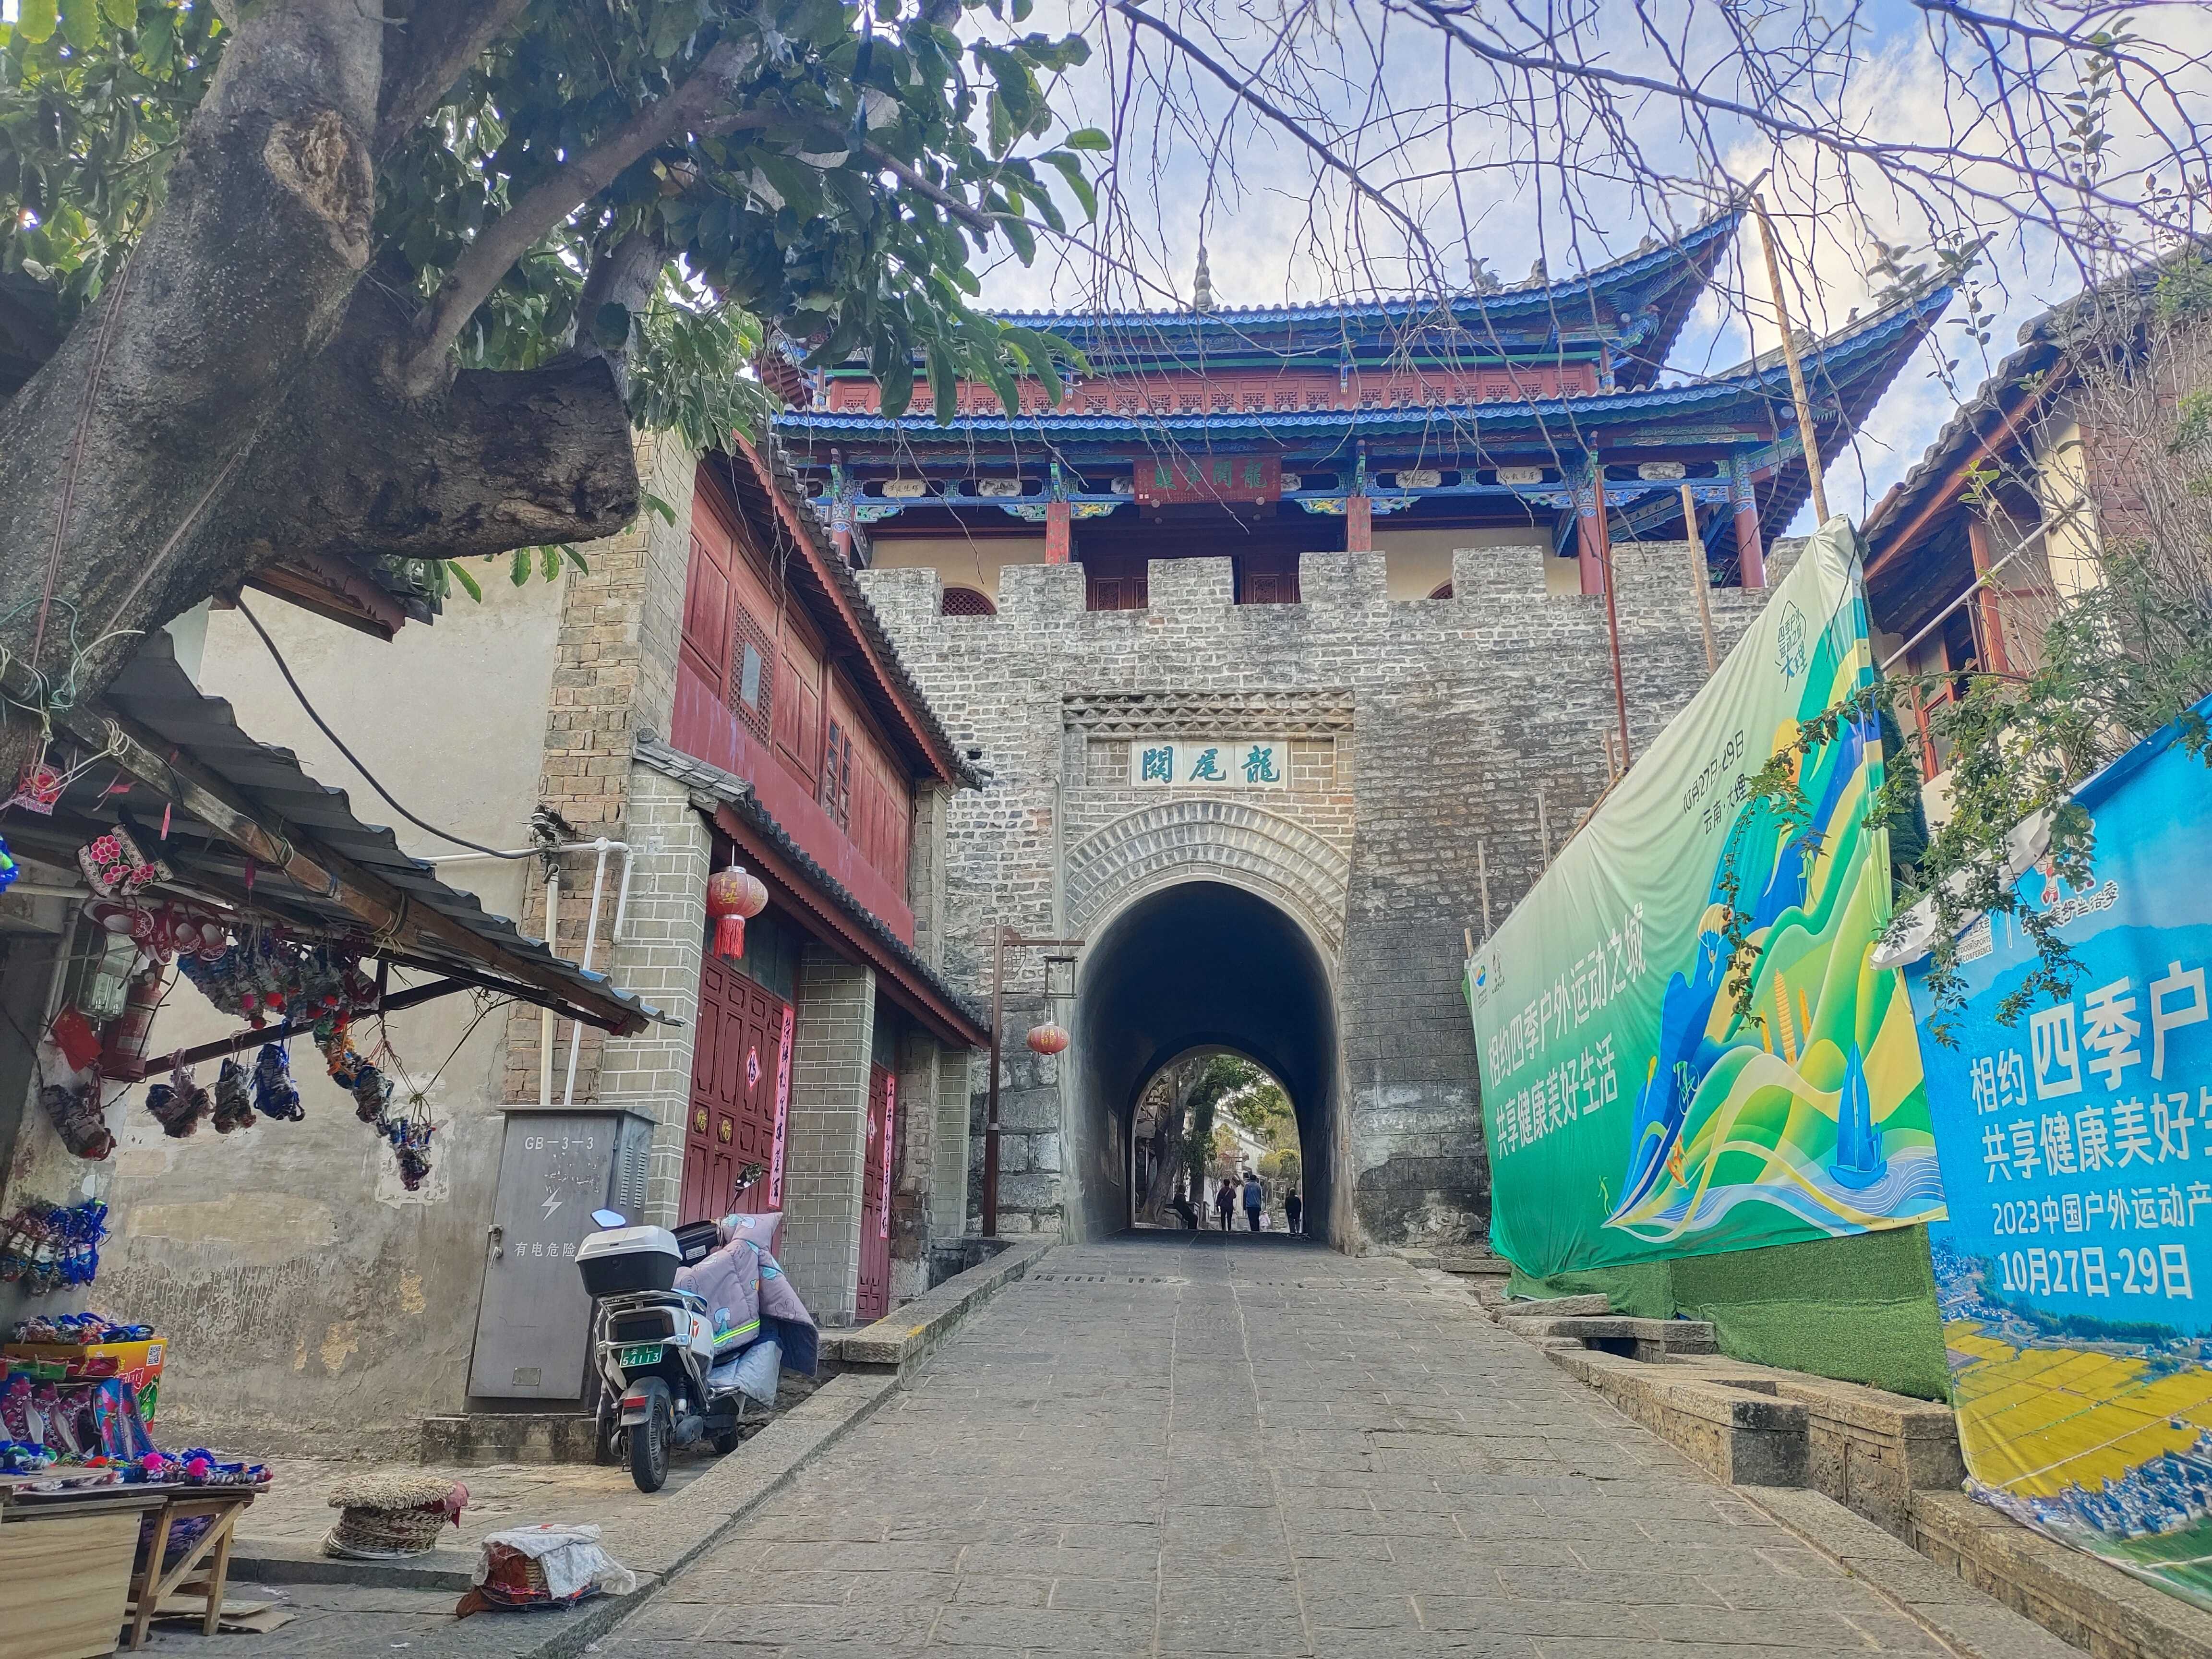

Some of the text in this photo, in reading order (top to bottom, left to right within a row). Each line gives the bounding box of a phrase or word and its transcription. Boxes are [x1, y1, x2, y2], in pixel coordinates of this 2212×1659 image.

[1683, 729, 1744, 815] 10月27日-29日
[1962, 944, 1992, 962] CONFERENCE
[1974, 935, 1991, 948] SPORTS
[1488, 902, 1647, 1090] 相约四季户外运动之城
[1496, 1033, 1618, 1160] 共享健康美好生活
[514, 1241, 576, 1257] 有电危险
[1998, 1244, 2193, 1299] 10月27日-29日
[623, 1353, 659, 1365] 54113
